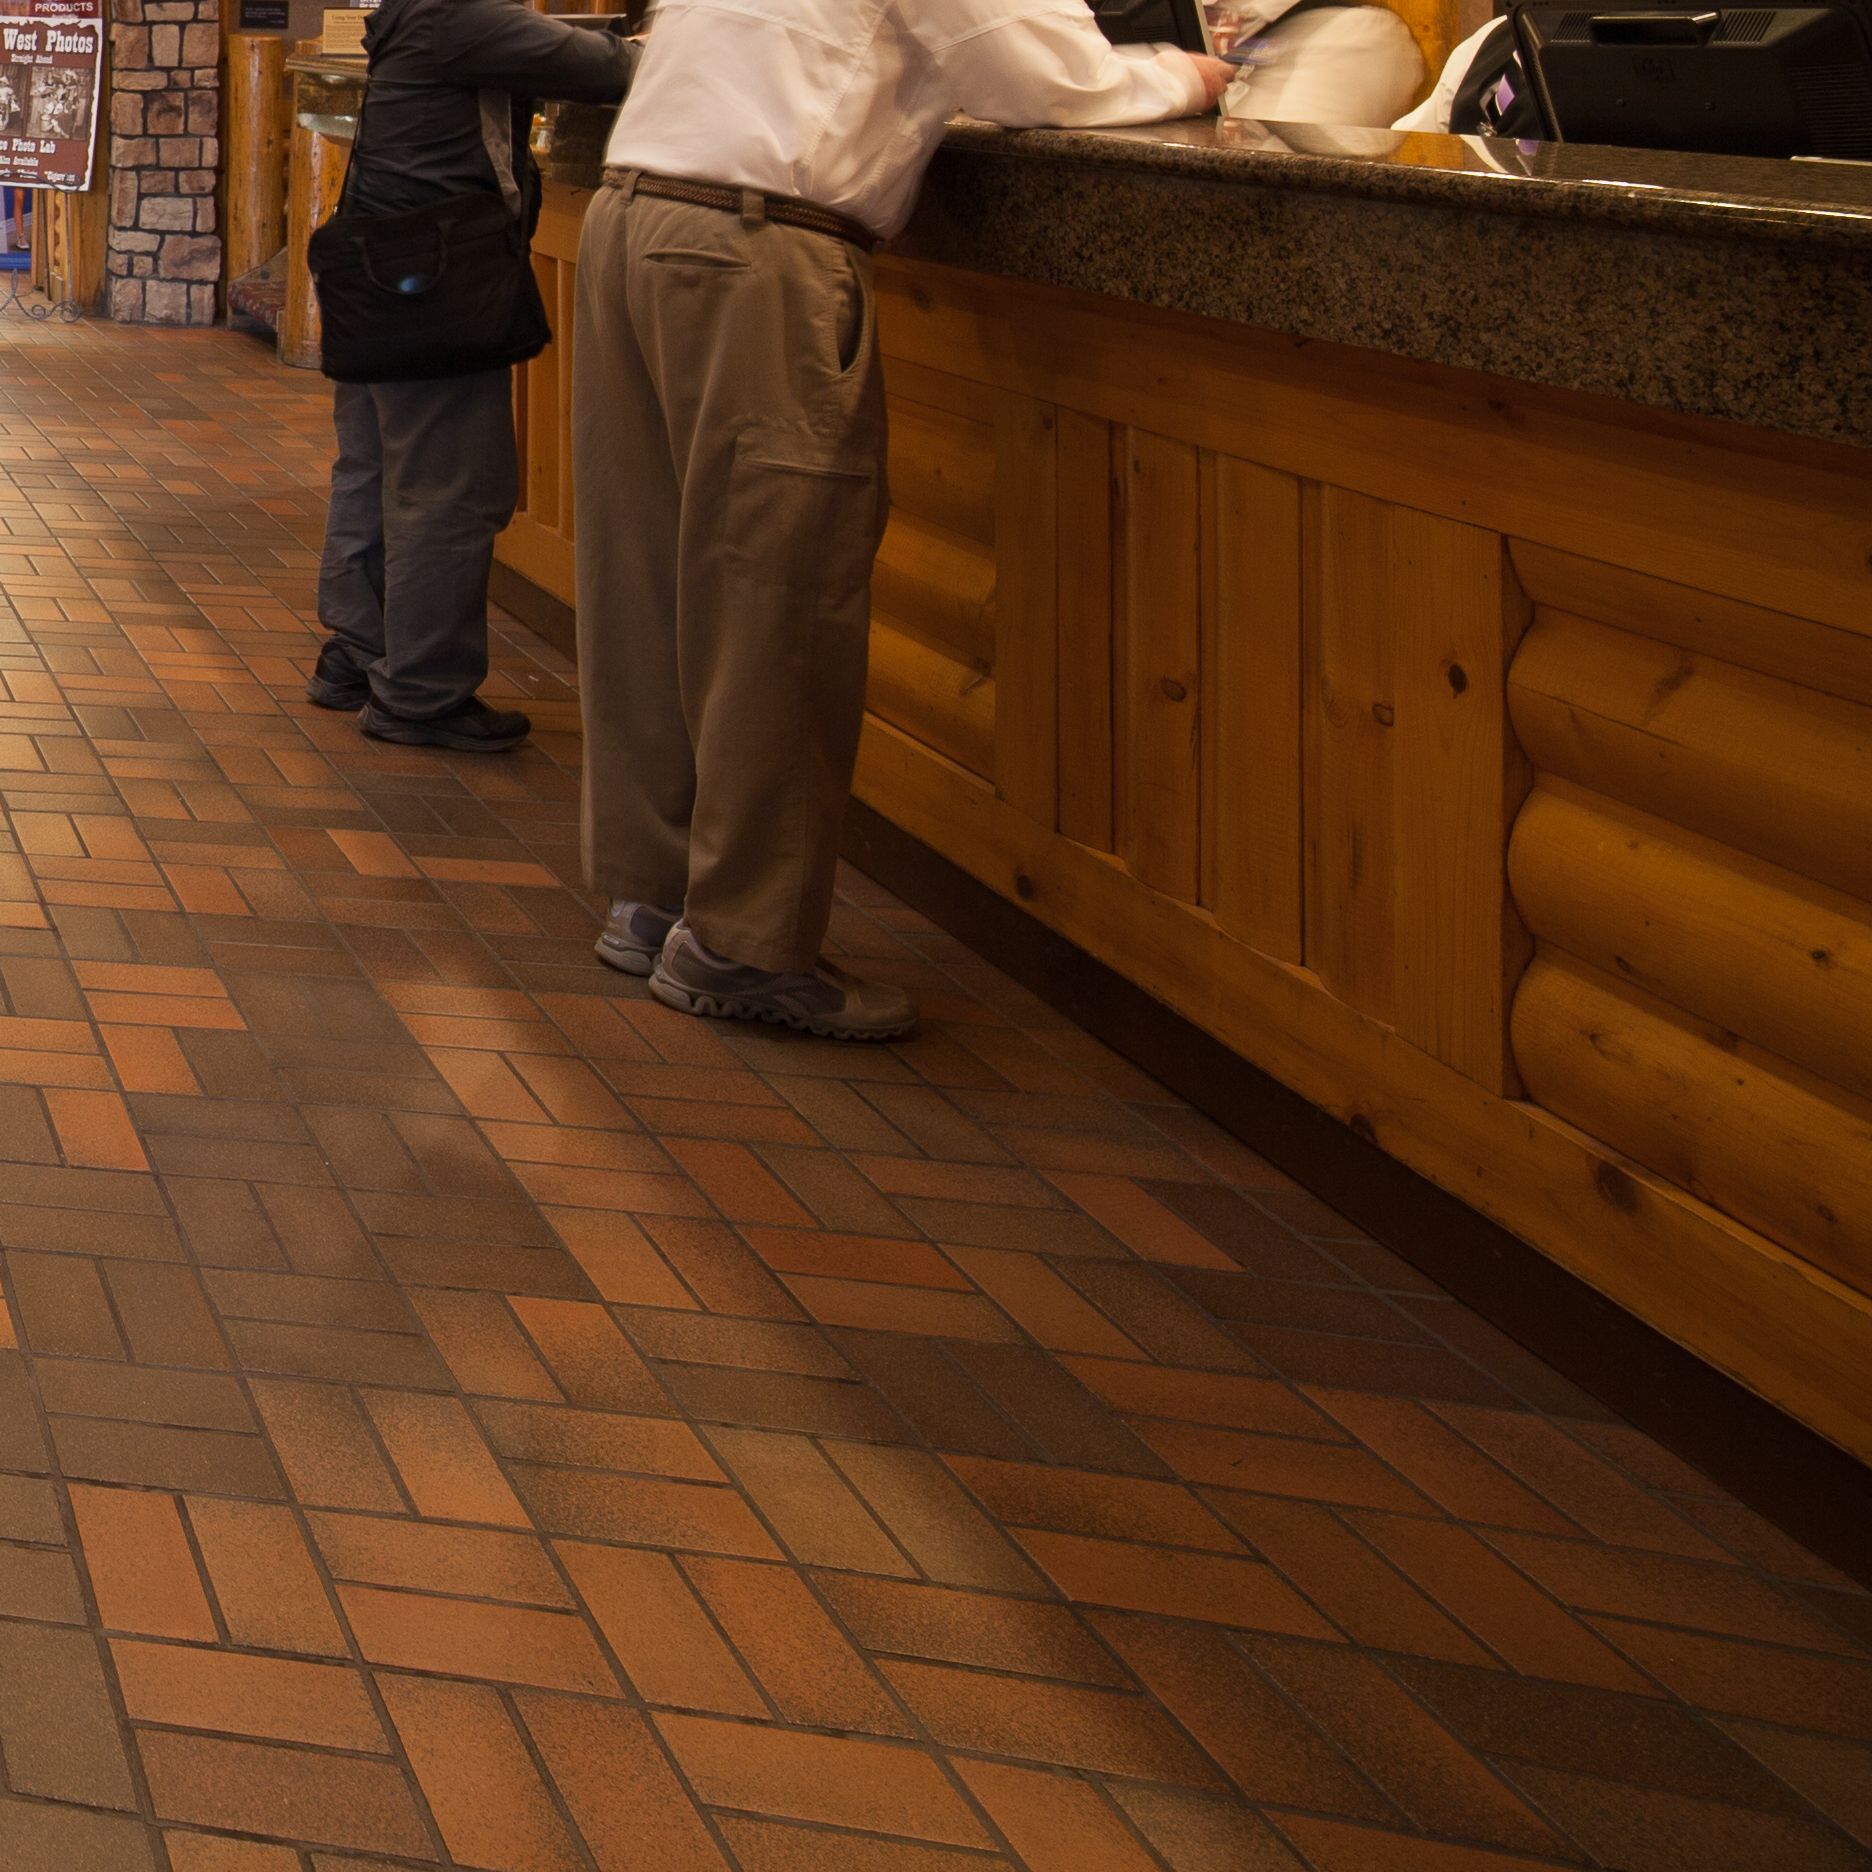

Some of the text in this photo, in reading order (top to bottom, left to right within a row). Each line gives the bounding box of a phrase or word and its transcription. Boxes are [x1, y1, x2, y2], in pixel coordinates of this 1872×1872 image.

[34, 2, 94, 13] PRODUCTS
[3, 28, 38, 51] West
[45, 30, 94, 54] Photos
[12, 138, 36, 153] Photo
[40, 139, 56, 154] Lab
